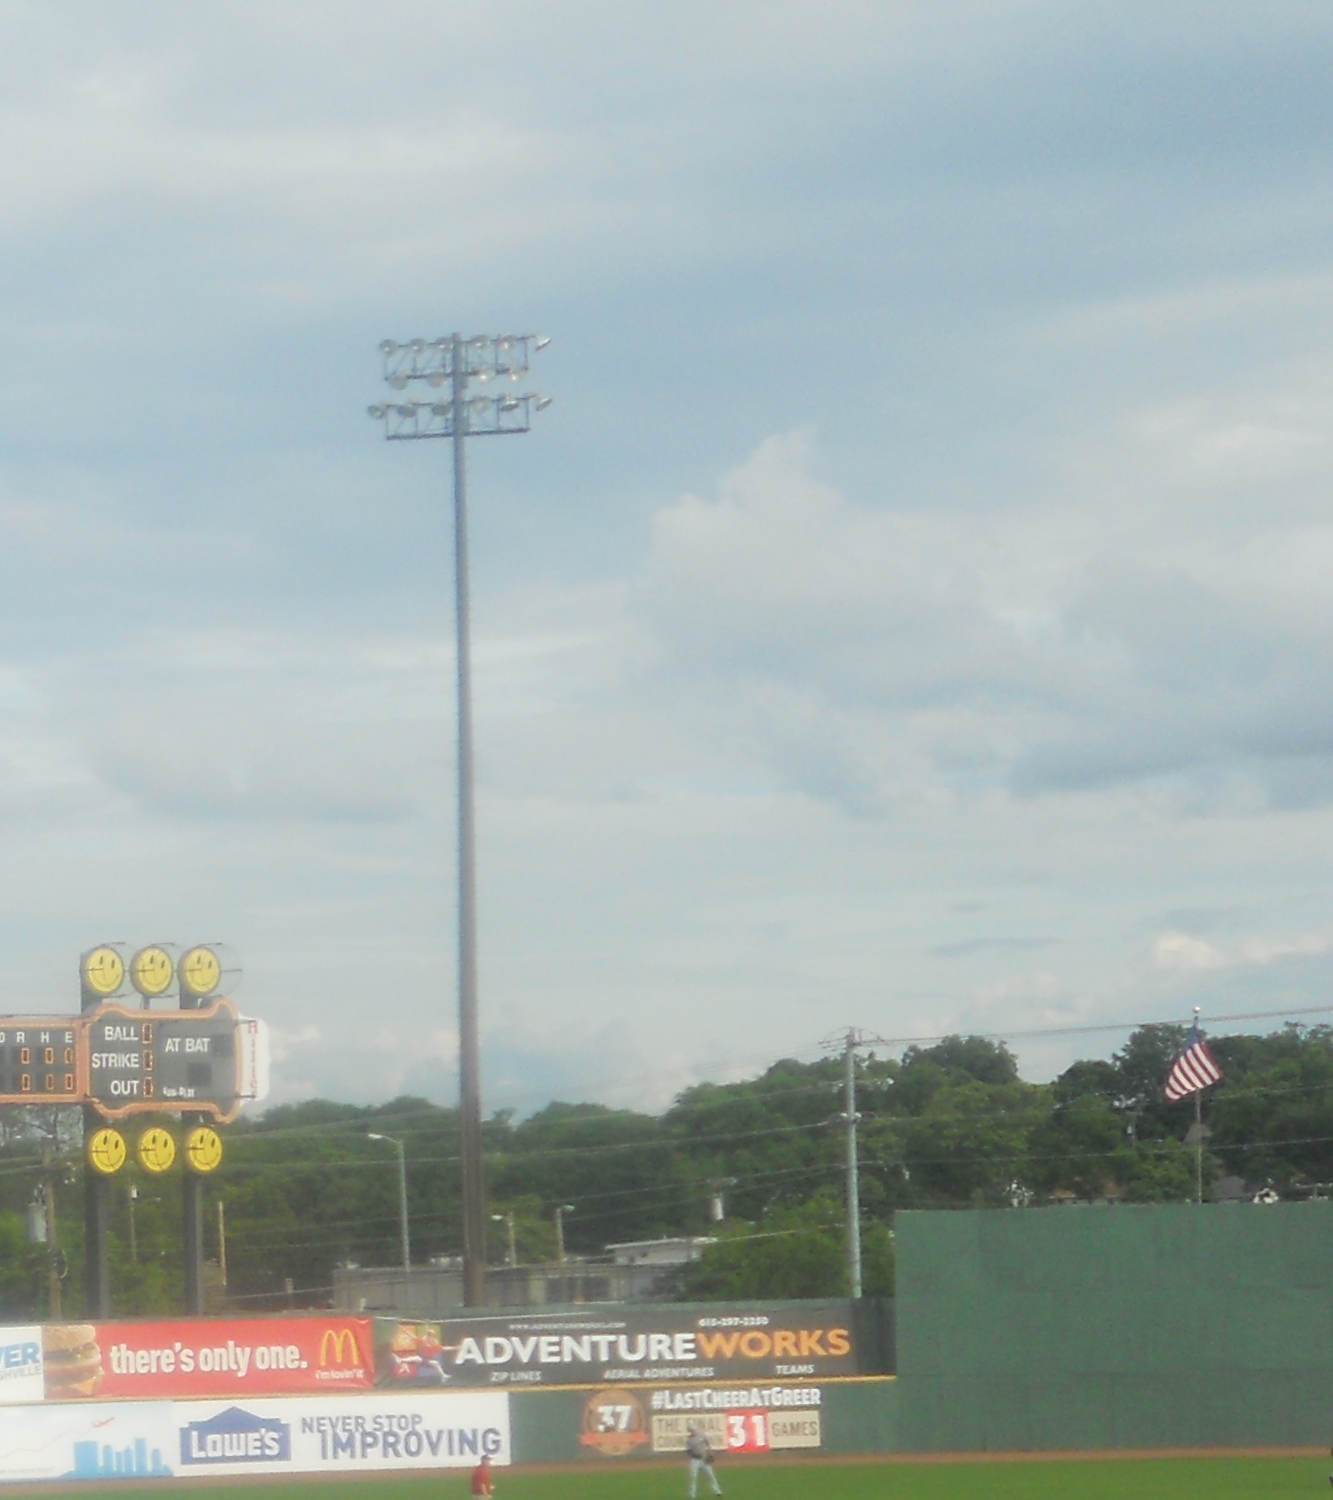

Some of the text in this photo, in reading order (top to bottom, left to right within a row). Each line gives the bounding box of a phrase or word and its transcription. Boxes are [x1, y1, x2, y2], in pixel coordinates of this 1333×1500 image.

[17, 1032, 25, 1044] R
[41, 1032, 49, 1044] H
[65, 1032, 73, 1044] E
[104, 1026, 139, 1041] BALL
[165, 1038, 210, 1052] AT BAT
[92, 1053, 139, 1068] STRIKE
[110, 1080, 140, 1095] OUT
[110, 1340, 308, 1378] there's only one.
[511, 1371, 541, 1381] LINES
[644, 1367, 715, 1378] ADVENTURES
[776, 1364, 815, 1374] TEAMS
[301, 1413, 423, 1434] NEVER STOP
[597, 1405, 631, 1432] 37
[772, 1421, 817, 1438] GAMES
[191, 1428, 280, 1459] LOWE'S
[320, 1427, 502, 1461] IMPROVING
